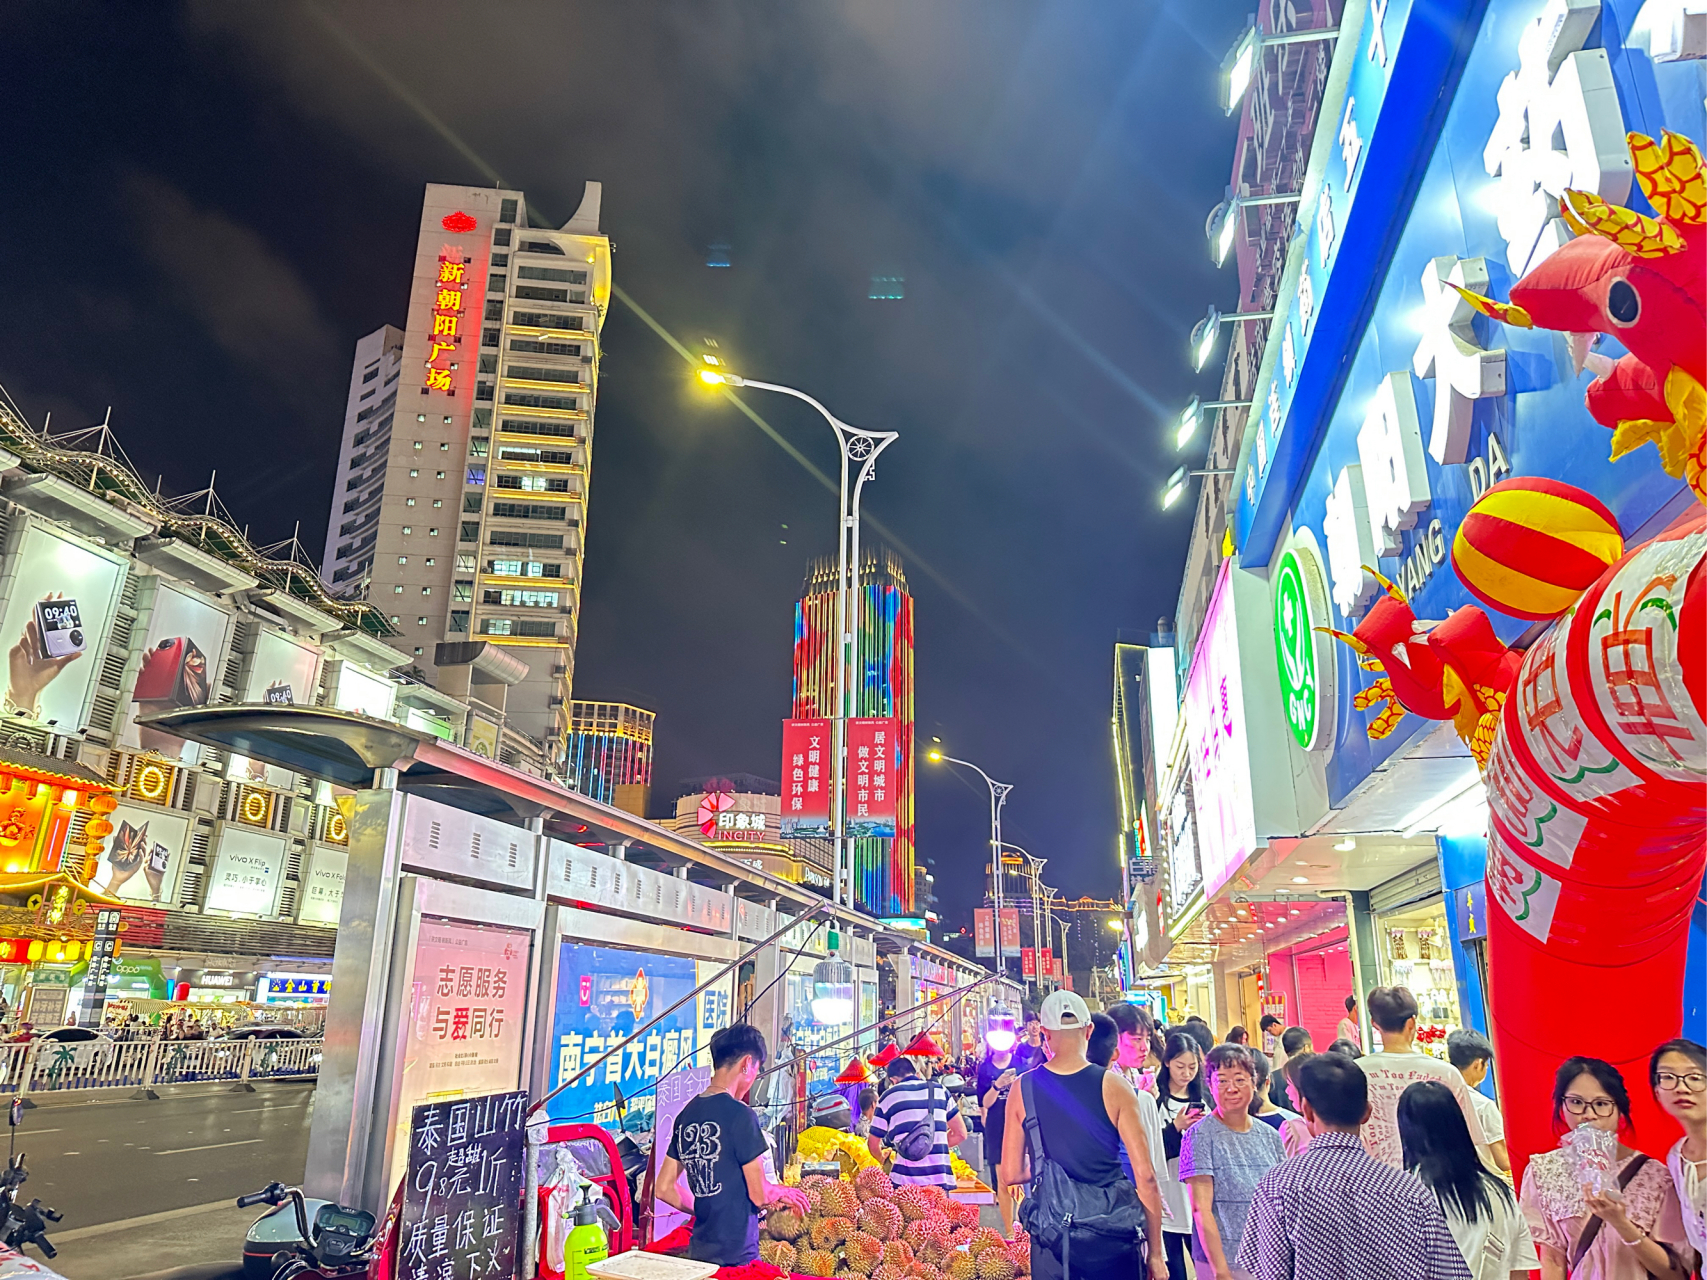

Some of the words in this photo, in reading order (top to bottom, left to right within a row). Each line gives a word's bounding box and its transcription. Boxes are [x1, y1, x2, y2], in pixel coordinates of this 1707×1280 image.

[426, 261, 465, 391] 新朝阳广场
[44, 605, 78, 620] 09:40
[791, 753, 805, 811] 绿色环保
[807, 736, 820, 792] 文明健康
[857, 745, 870, 817] 做文明市民
[873, 731, 886, 802] 居文明城市
[717, 830, 766, 842] INCITY
[718, 812, 767, 831] 印象城
[229, 853, 248, 863] vivo
[201, 975, 234, 986] HUAWEI
[436, 964, 508, 999] 志愿服务
[432, 1006, 504, 1041] 与爱同行
[702, 989, 729, 1029] 医院
[416, 1095, 527, 1155] 泰国山竹
[444, 1143, 482, 1172] 超甜
[403, 1204, 504, 1266] 质量保证
